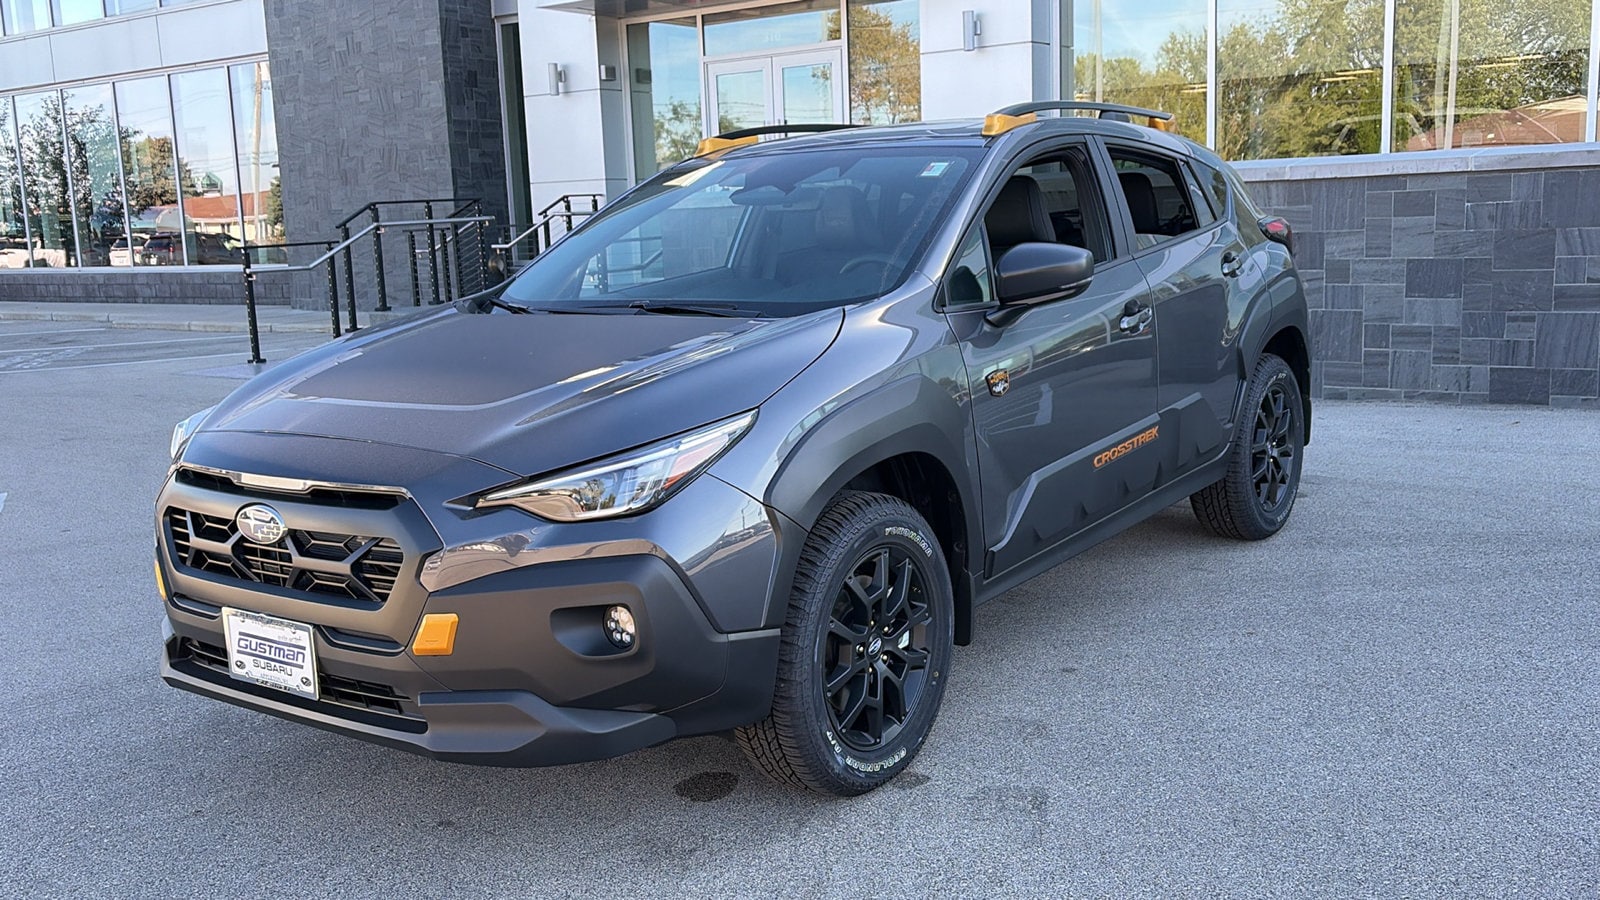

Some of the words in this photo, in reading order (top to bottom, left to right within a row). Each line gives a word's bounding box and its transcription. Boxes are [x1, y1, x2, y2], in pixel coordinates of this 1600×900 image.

[1093, 425, 1159, 468] CROSSTREK
[884, 526, 933, 558] YOKOHAMA
[252, 659, 293, 677] SUBARU
